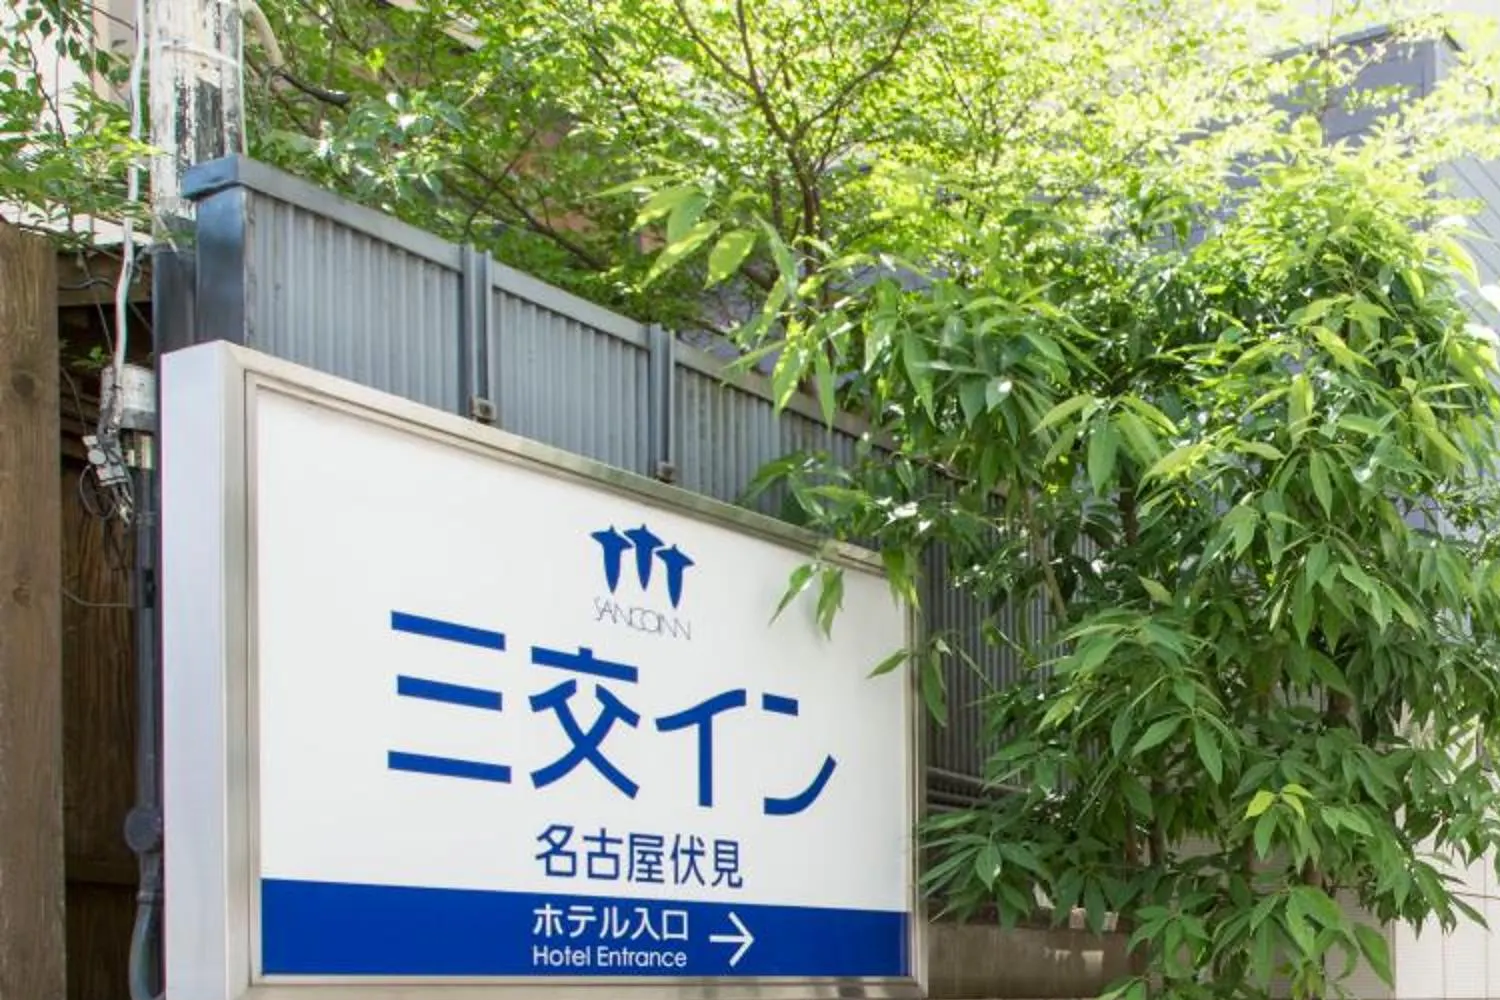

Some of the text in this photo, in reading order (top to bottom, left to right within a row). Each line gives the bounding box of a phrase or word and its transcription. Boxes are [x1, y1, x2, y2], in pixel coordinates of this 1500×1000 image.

[388, 609, 837, 816] 三交イン
[535, 823, 743, 889] 名古屋伏見
[532, 902, 689, 942] ホテル入口
[532, 945, 688, 968] Hotel Entrance
